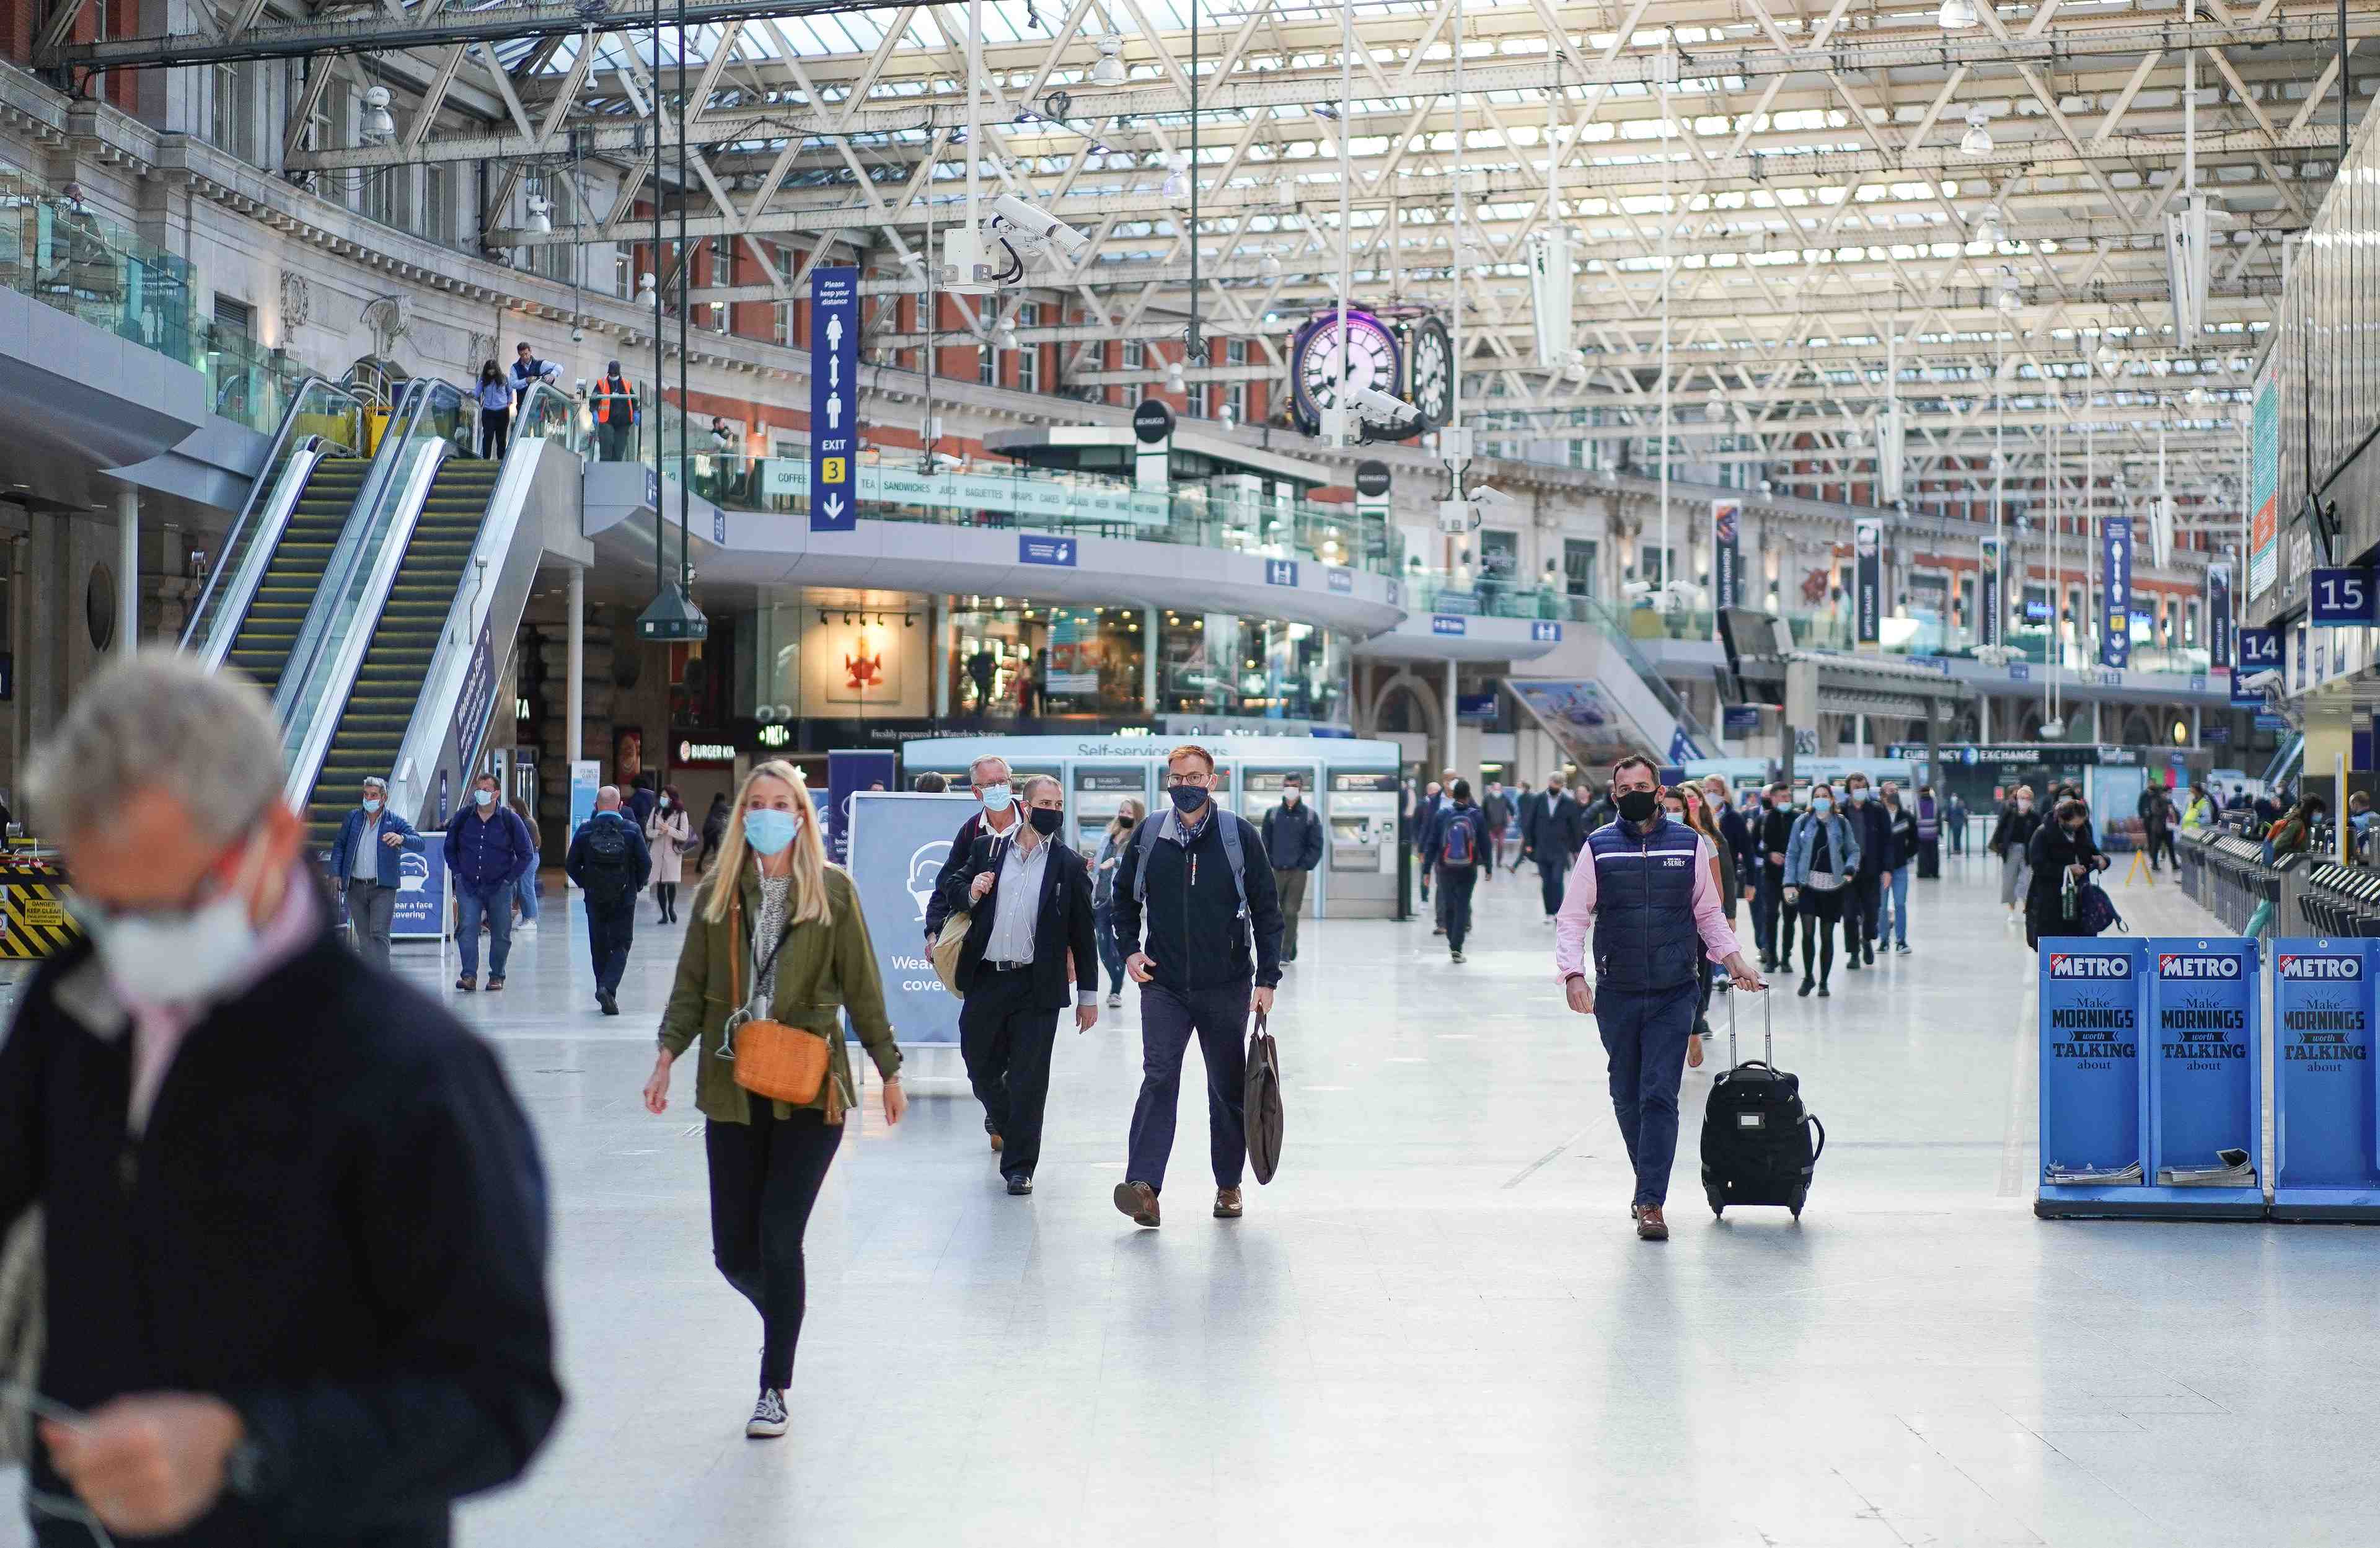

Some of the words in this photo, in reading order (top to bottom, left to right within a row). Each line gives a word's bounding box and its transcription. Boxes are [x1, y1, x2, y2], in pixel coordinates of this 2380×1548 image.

[822, 440, 846, 451] EXIT
[828, 461, 839, 479] 3
[778, 472, 807, 484] COFFEE
[861, 478, 875, 489] TEA
[884, 481, 930, 493] SANDWICHES
[939, 485, 958, 495] JUICE
[966, 488, 1003, 499] BAGUETTES
[2320, 579, 2363, 611] 15
[2246, 635, 2279, 660] 14
[457, 671, 477, 727] Waterloo
[516, 699, 530, 719] TA
[871, 728, 897, 740] Freshly
[899, 729, 931, 740] prepared
[941, 729, 977, 738] Waterloo
[691, 744, 722, 759] BURGER
[1078, 744, 1170, 756] Self-service
[1979, 750, 2039, 761] EXCHANGE
[416, 901, 433, 909] face
[2054, 958, 2128, 976] METRO
[2164, 958, 2238, 976] METRO
[2284, 959, 2359, 978] METRO
[2077, 997, 2110, 1008] Make
[2186, 999, 2220, 1009] Make
[2307, 999, 2340, 1009] Make
[2053, 1009, 2133, 1028] MORNINGS
[2161, 1010, 2244, 1029] MORNINGS
[2284, 1011, 2365, 1030] MORNINGS
[2082, 1032, 2105, 1040] worth
[2192, 1032, 2215, 1041] worth
[2312, 1033, 2336, 1042] worth
[2053, 1043, 2136, 1058] TALKING
[2162, 1044, 2246, 1059] TALKING
[2284, 1045, 2366, 1060] TALKING
[2078, 1059, 2112, 1070] about
[2187, 1061, 2221, 1071] about
[2307, 1062, 2342, 1072] about
